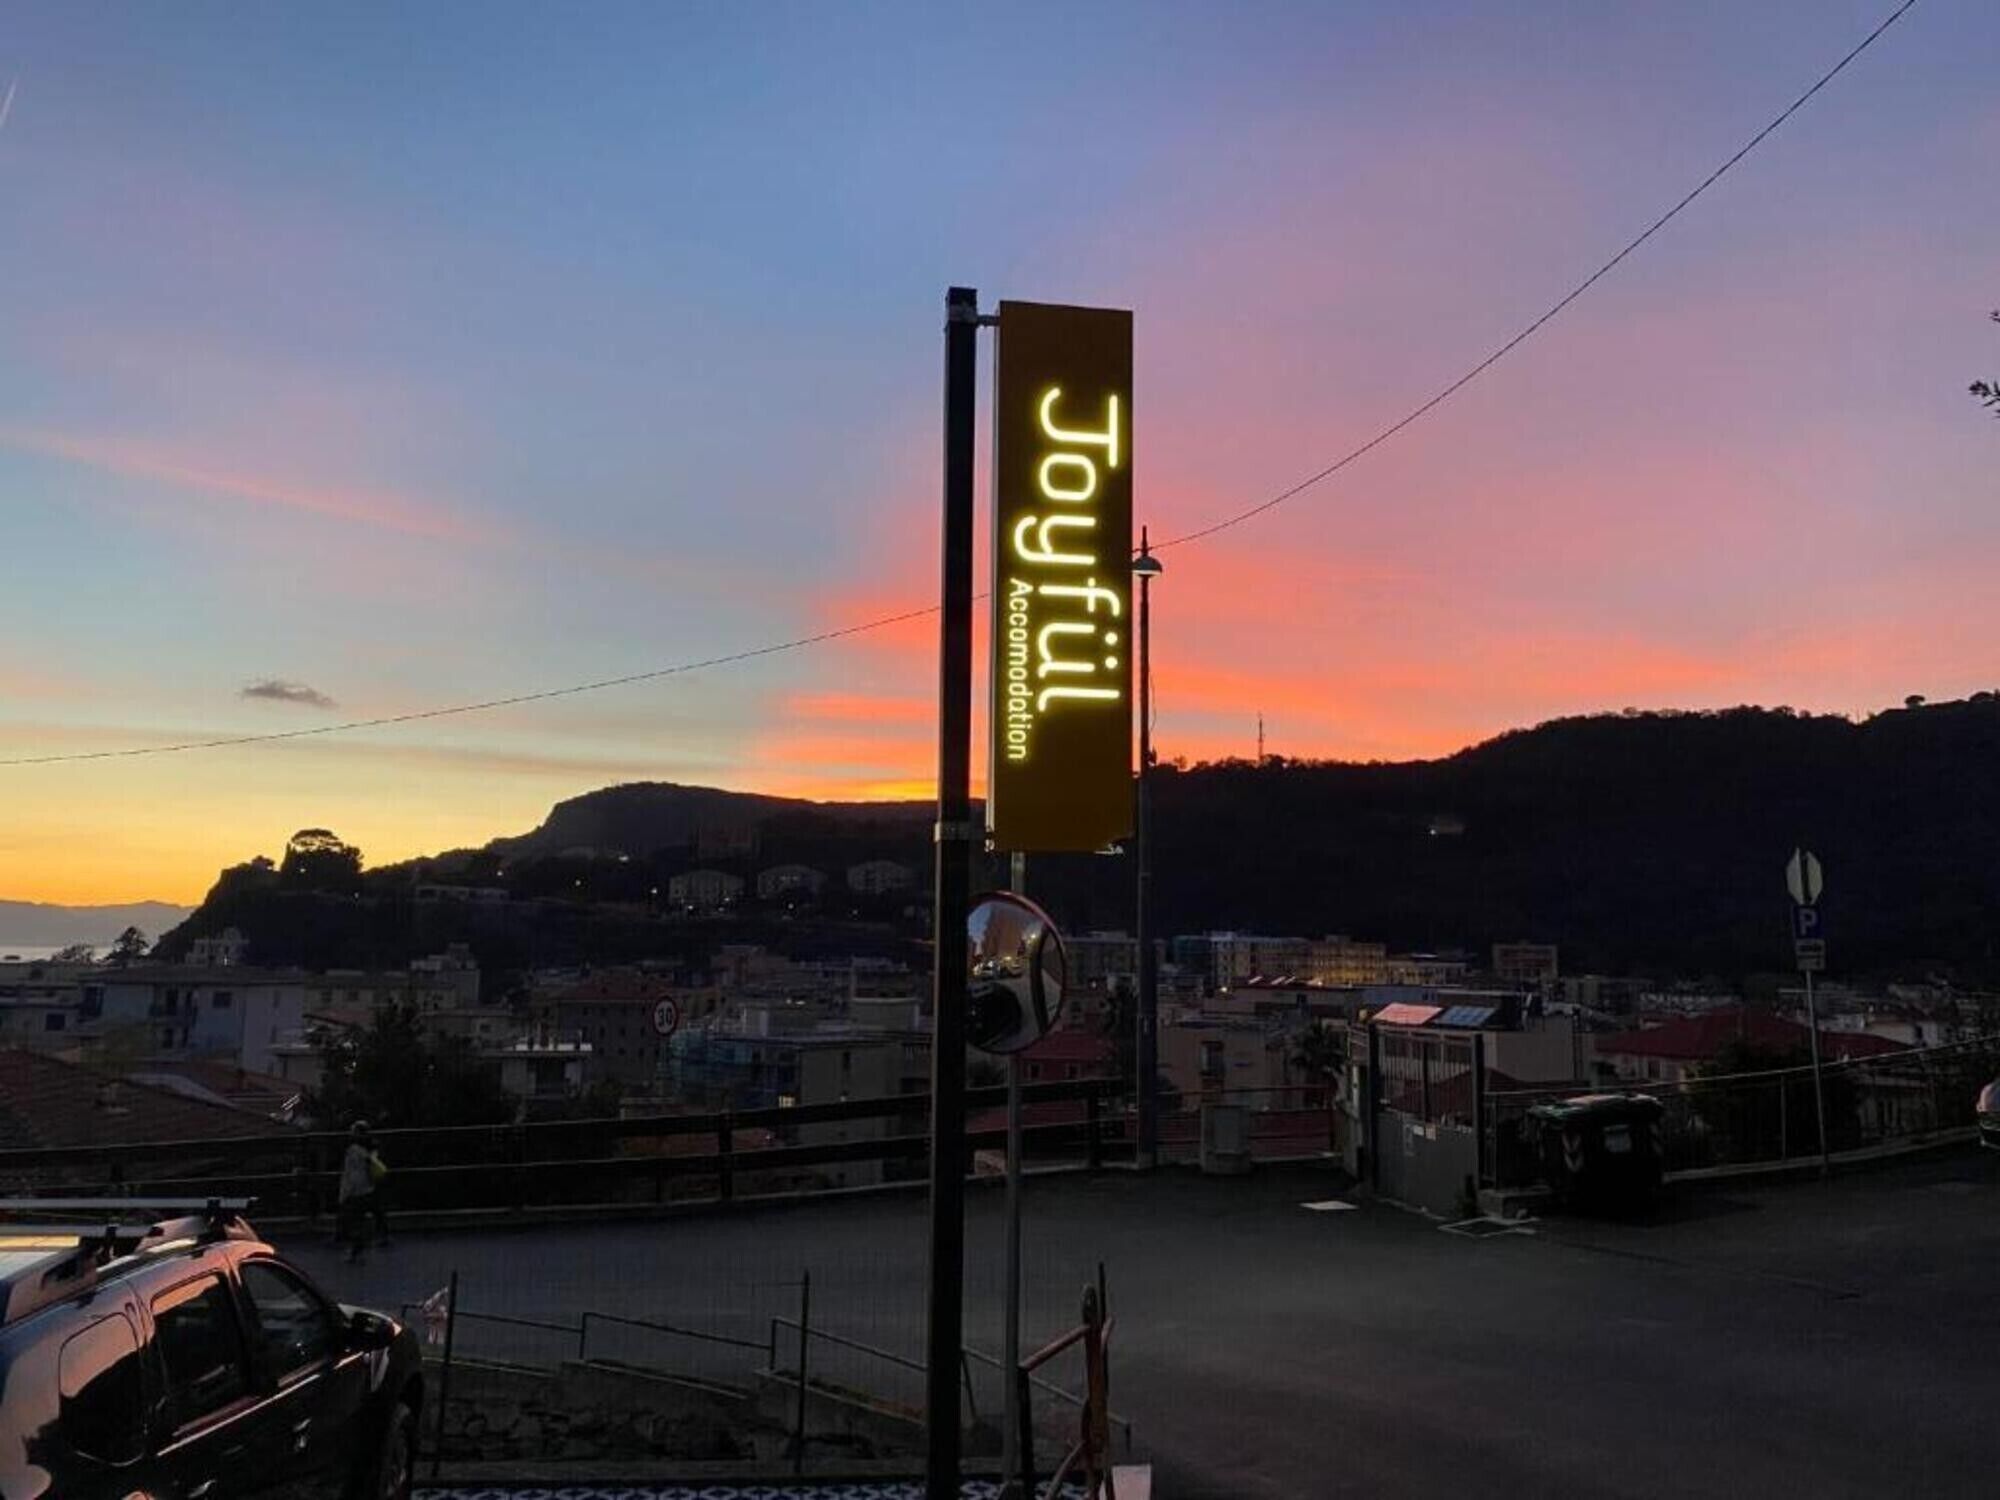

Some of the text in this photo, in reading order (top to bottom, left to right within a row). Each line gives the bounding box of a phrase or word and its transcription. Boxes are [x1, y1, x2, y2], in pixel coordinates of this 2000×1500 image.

[1013, 387, 1120, 712] Joyfül
[1008, 577, 1034, 760] Accomodation
[1799, 908, 1818, 936] P
[657, 1007, 673, 1027] 30
